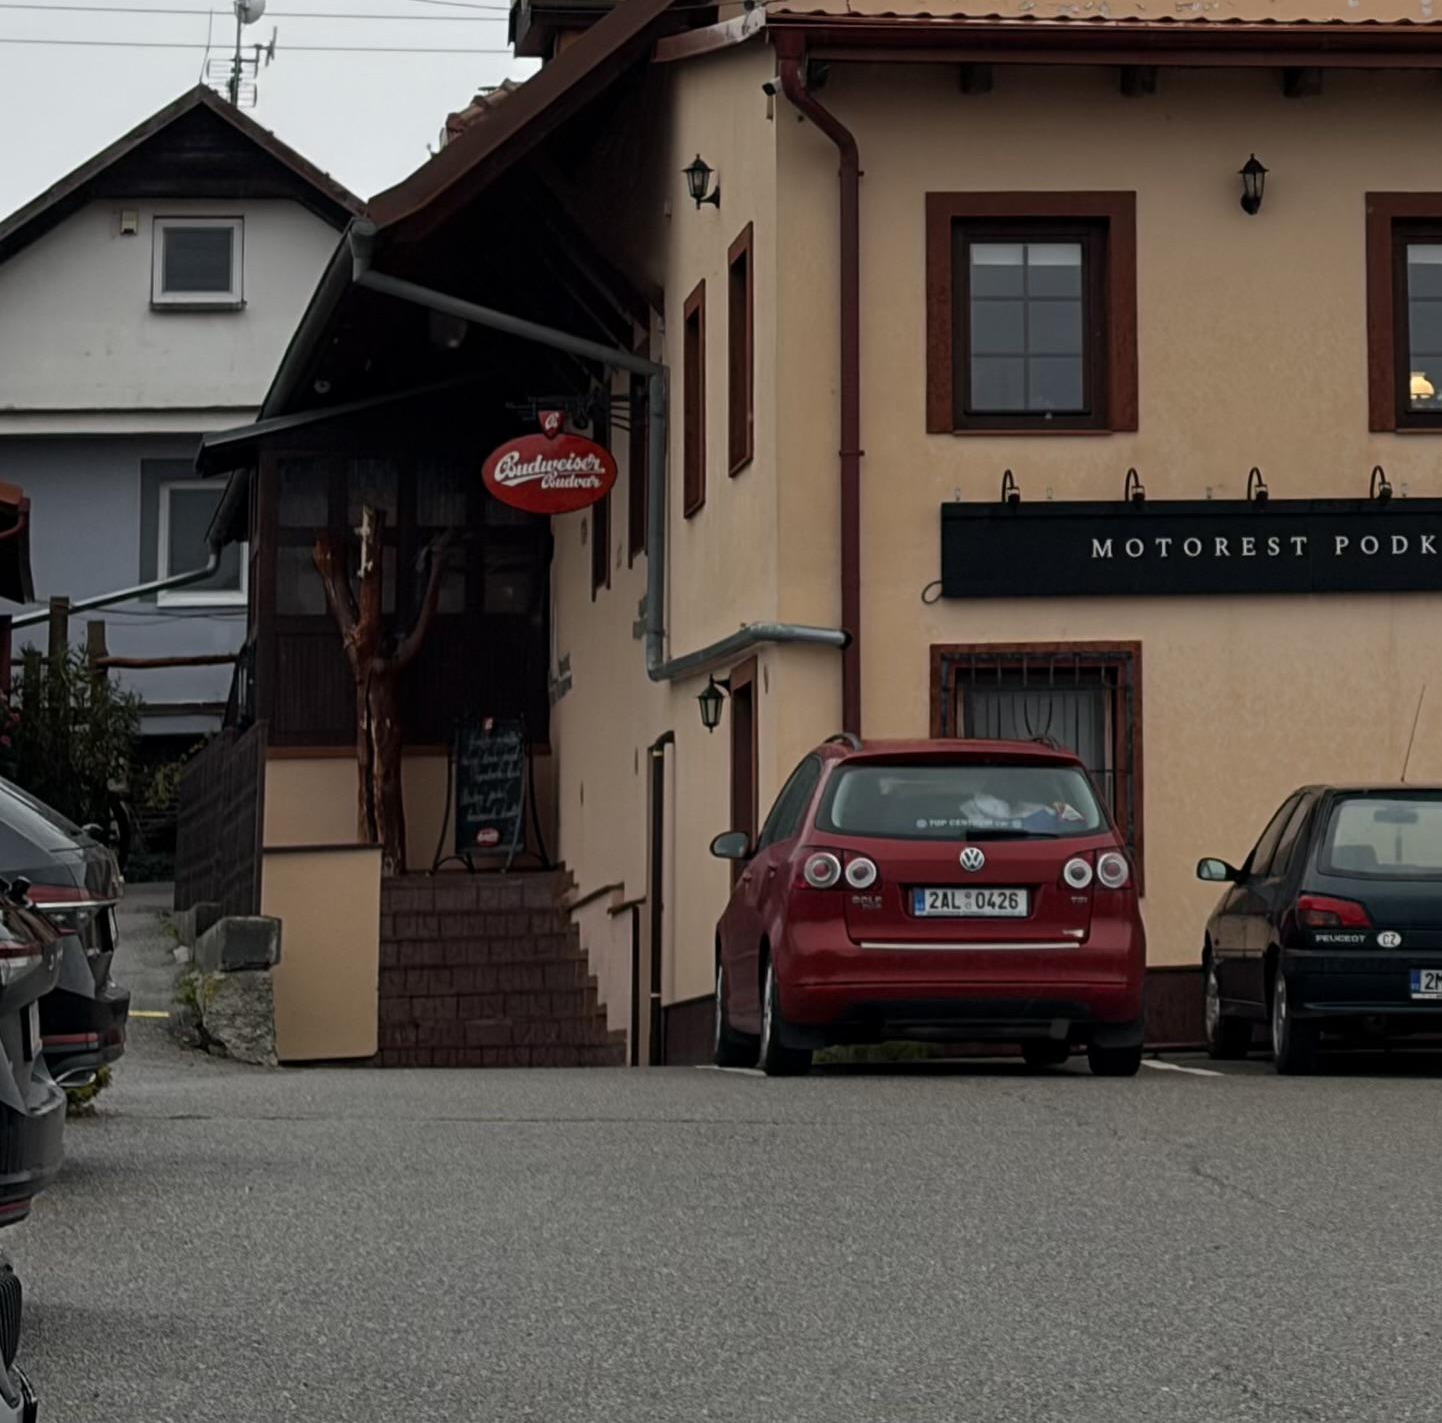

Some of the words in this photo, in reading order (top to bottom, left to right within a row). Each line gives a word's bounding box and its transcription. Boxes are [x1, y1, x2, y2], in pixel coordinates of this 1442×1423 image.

[541, 474, 603, 489] Budvar
[1091, 537, 1307, 558] MOTOREST
[929, 892, 961, 910] 2AL
[975, 892, 1019, 910] 0426
[1315, 934, 1366, 943] PEUGEOT
